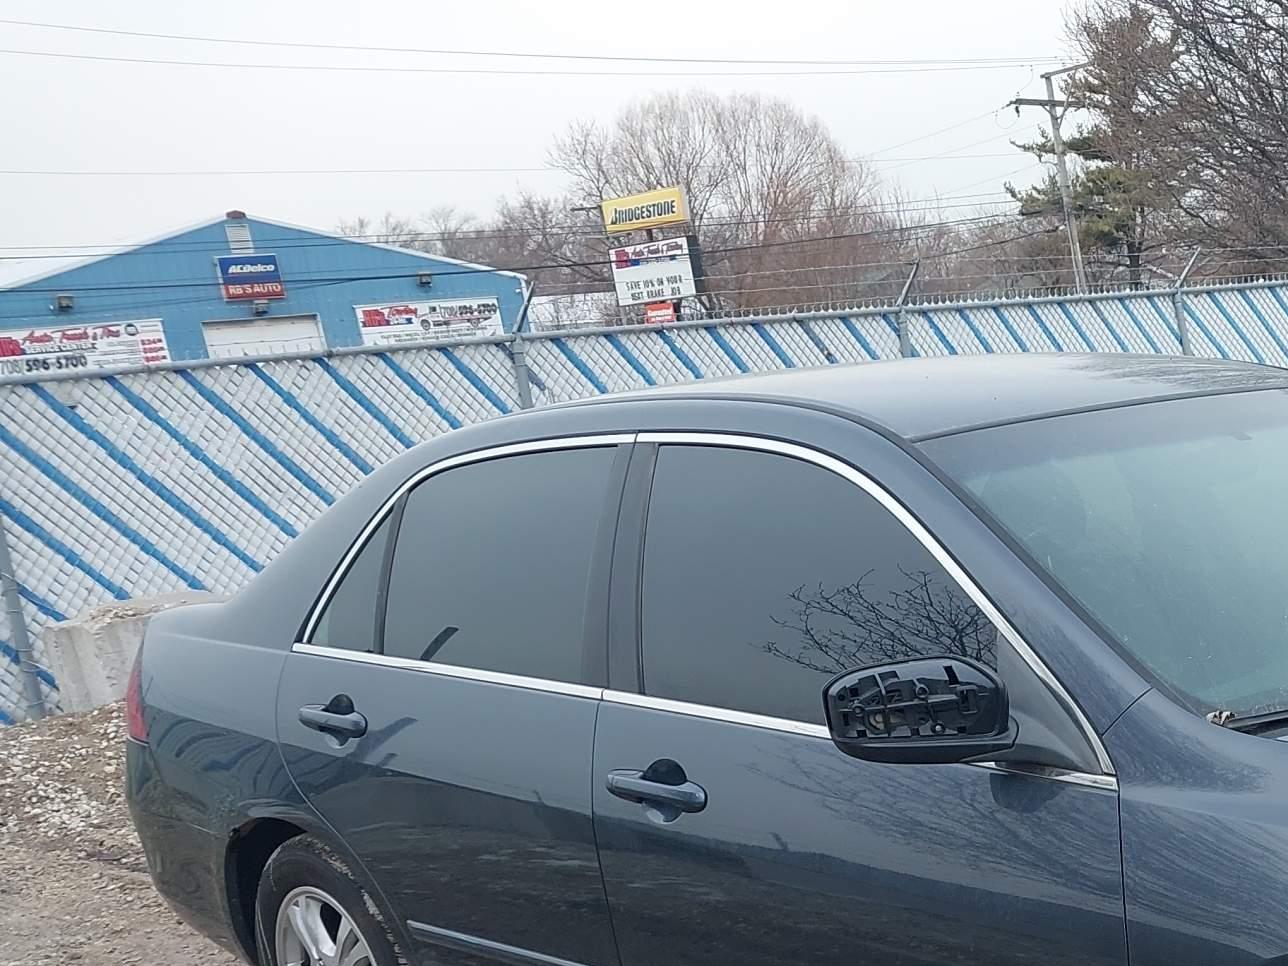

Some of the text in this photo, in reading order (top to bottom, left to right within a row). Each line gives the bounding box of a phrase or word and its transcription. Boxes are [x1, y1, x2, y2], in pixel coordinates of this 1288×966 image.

[611, 200, 676, 225] BRIDGESTONE
[228, 264, 275, 274] ACDelco
[253, 282, 281, 294] AUTO
[626, 274, 683, 291] SAVE 10% ON YOUR
[647, 288, 665, 299] BRAKE
[671, 286, 682, 296] JOB
[25, 355, 88, 373] 596-5700
